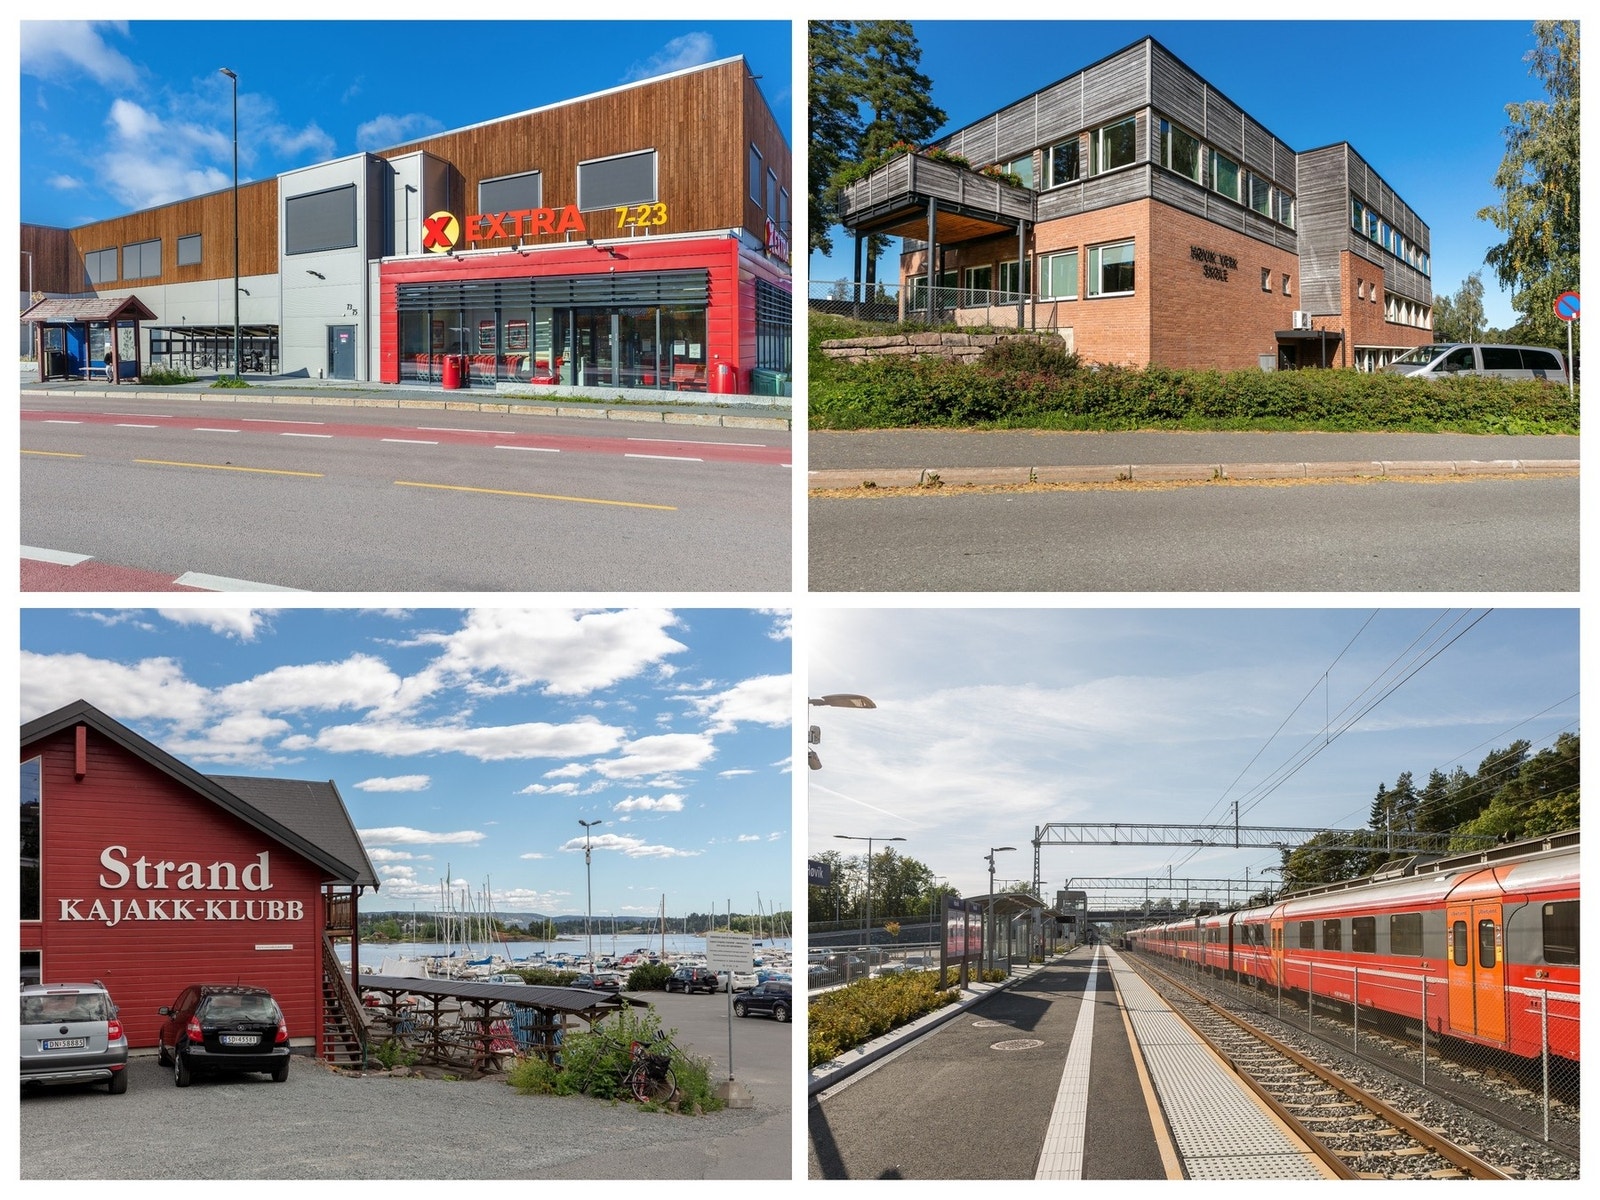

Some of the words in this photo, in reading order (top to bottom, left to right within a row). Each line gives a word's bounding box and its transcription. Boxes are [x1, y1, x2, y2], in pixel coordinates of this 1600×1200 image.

[465, 204, 586, 242] EXTRA
[616, 202, 668, 229] 7-23
[99, 845, 273, 891] Strand
[58, 898, 304, 927] KAJAKK-KLUBB
